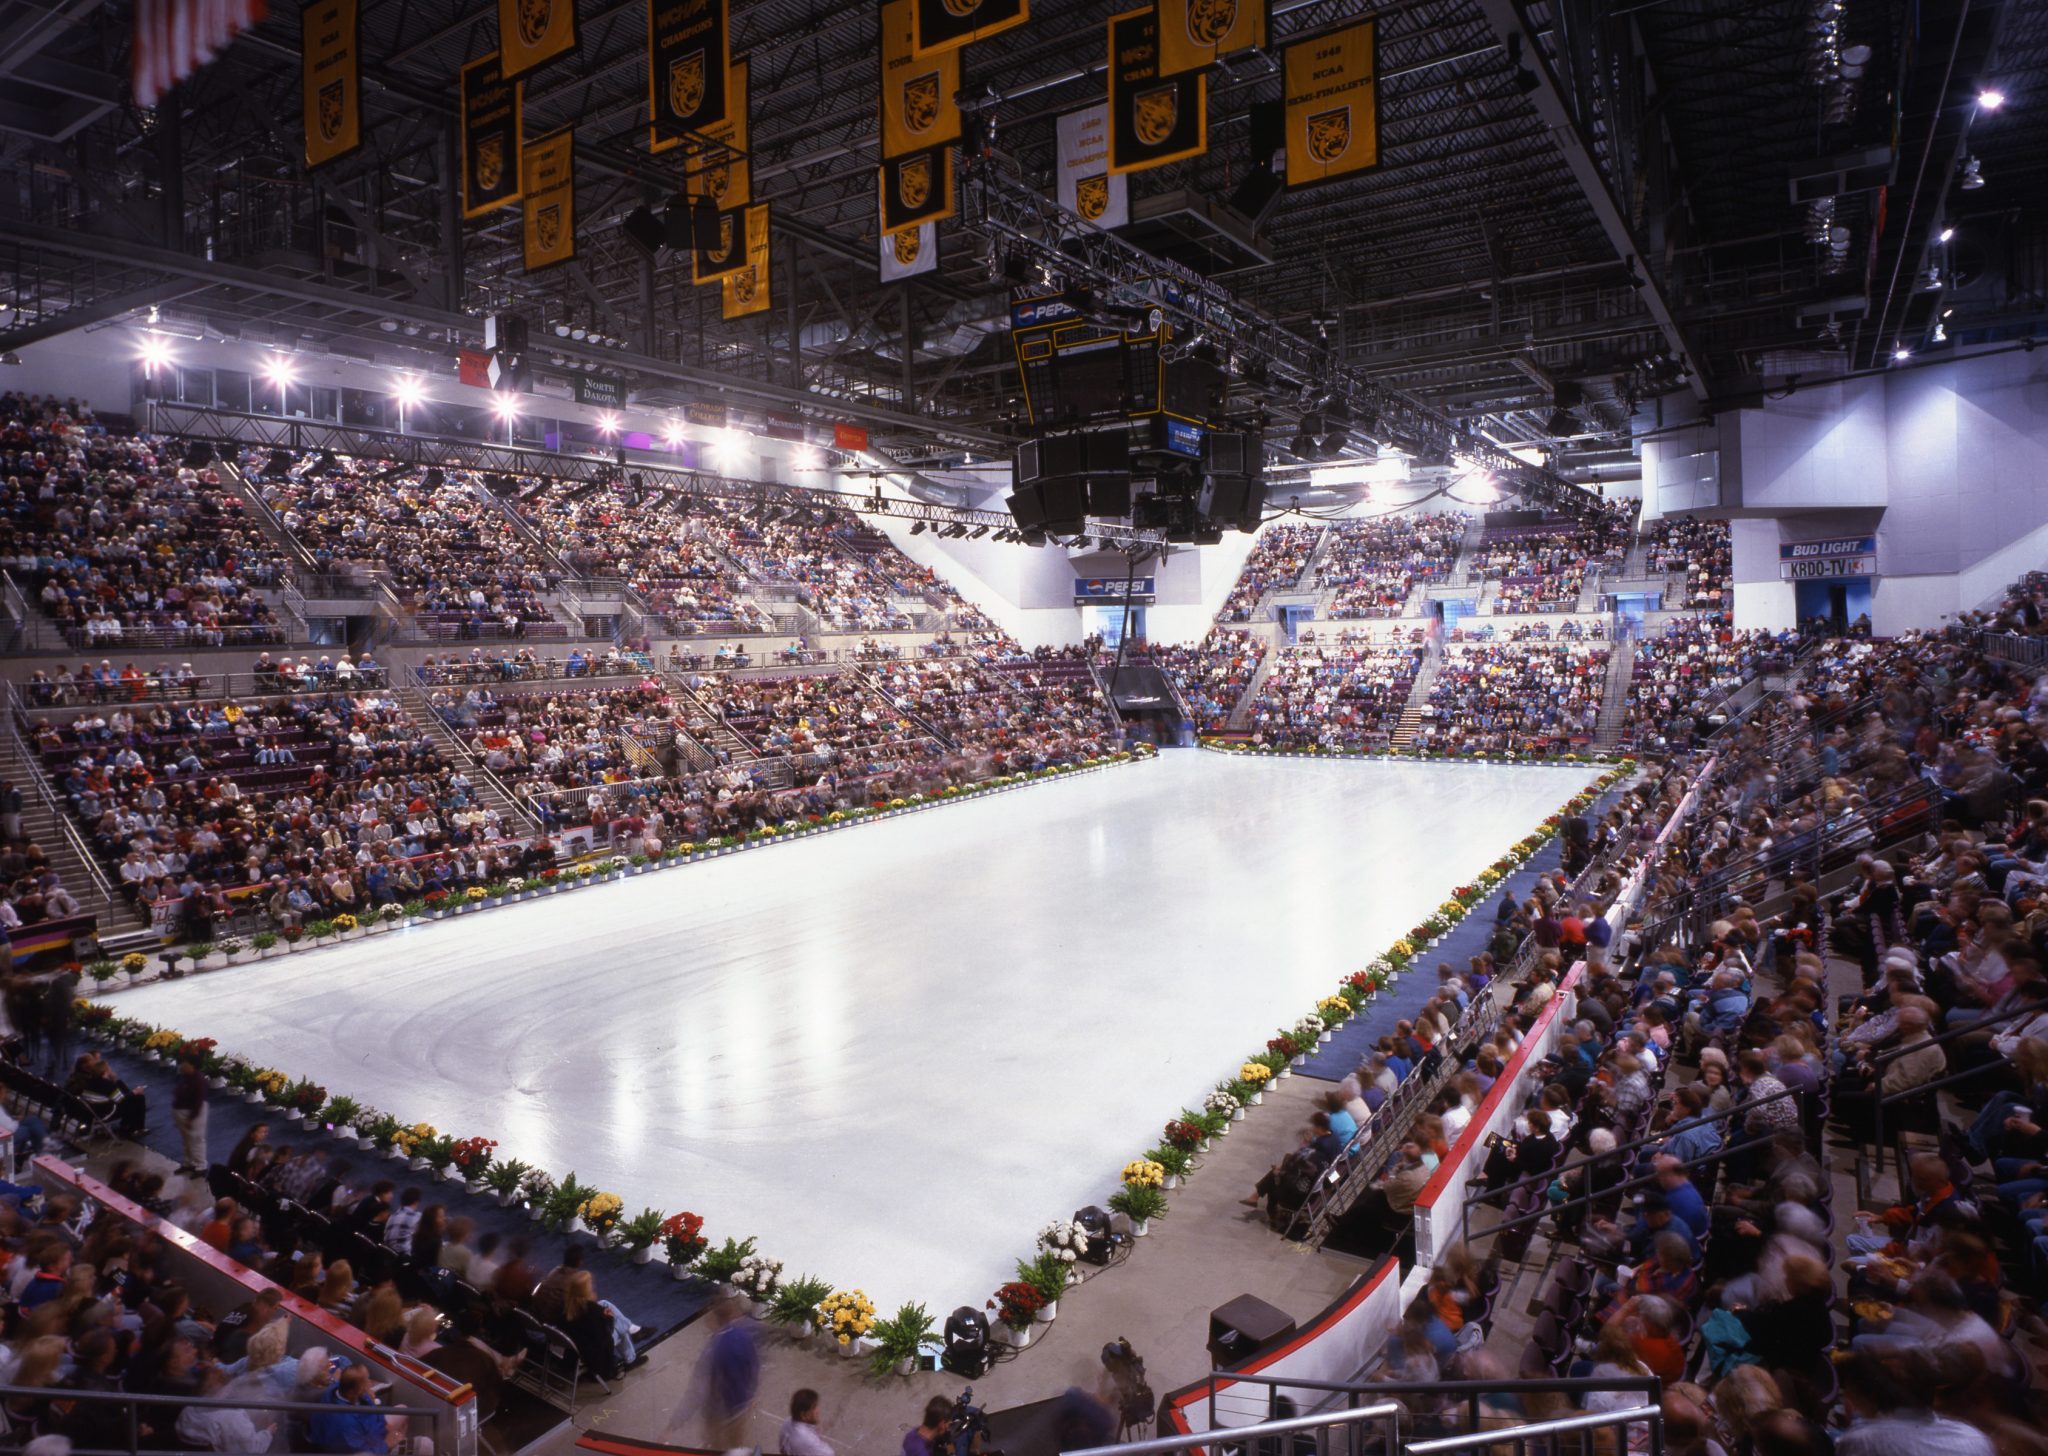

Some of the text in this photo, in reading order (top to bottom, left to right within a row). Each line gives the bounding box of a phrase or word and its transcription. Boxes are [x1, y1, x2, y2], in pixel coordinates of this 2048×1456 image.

[660, 15, 713, 48] CHAMPIONS
[1313, 65, 1344, 80] NCAA
[1287, 75, 1371, 106] SEMI-FINALISTS
[1035, 302, 1077, 319] PEPS
[585, 377, 615, 393] NORTH
[583, 389, 618, 404] DAKOTA
[1792, 541, 1860, 556] BUD LIGHT
[1791, 559, 1846, 577] KRDO-TV
[1104, 581, 1145, 592] PEPSI
